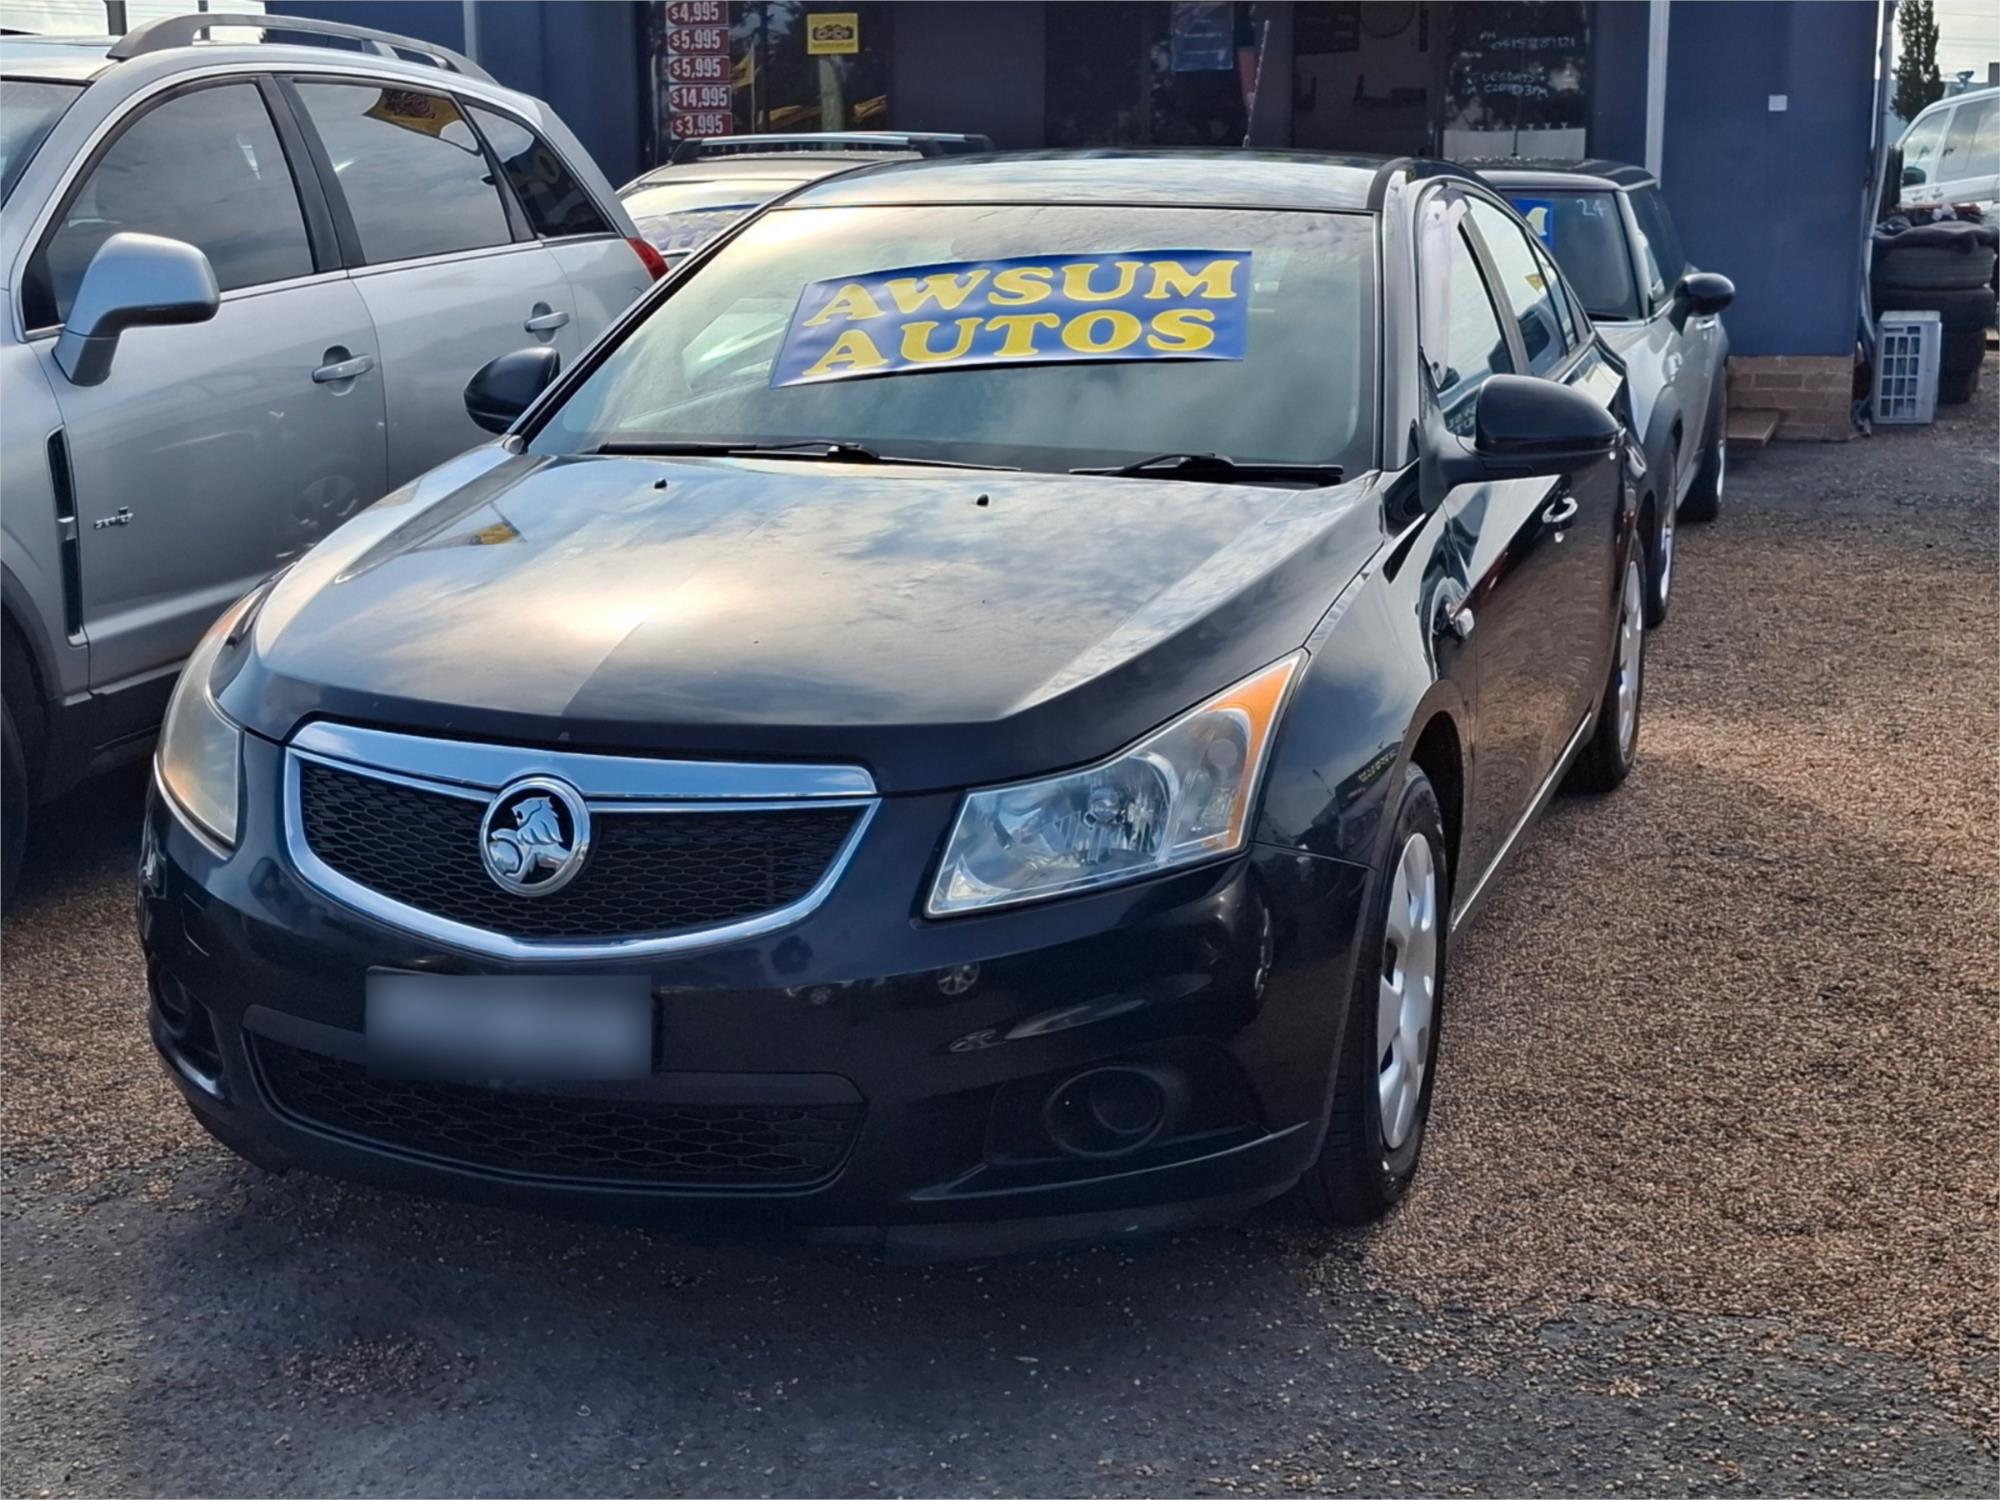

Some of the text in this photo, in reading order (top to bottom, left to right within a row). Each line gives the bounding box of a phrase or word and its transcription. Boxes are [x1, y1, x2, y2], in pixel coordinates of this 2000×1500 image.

[671, 1, 719, 22] $4,995
[672, 29, 720, 50] $5,995
[672, 58, 721, 78] $5,995
[672, 87, 728, 108] $14,995
[675, 115, 724, 136] $3,995
[802, 259, 1242, 328] AWSUM
[802, 308, 1216, 376] AUTOS
